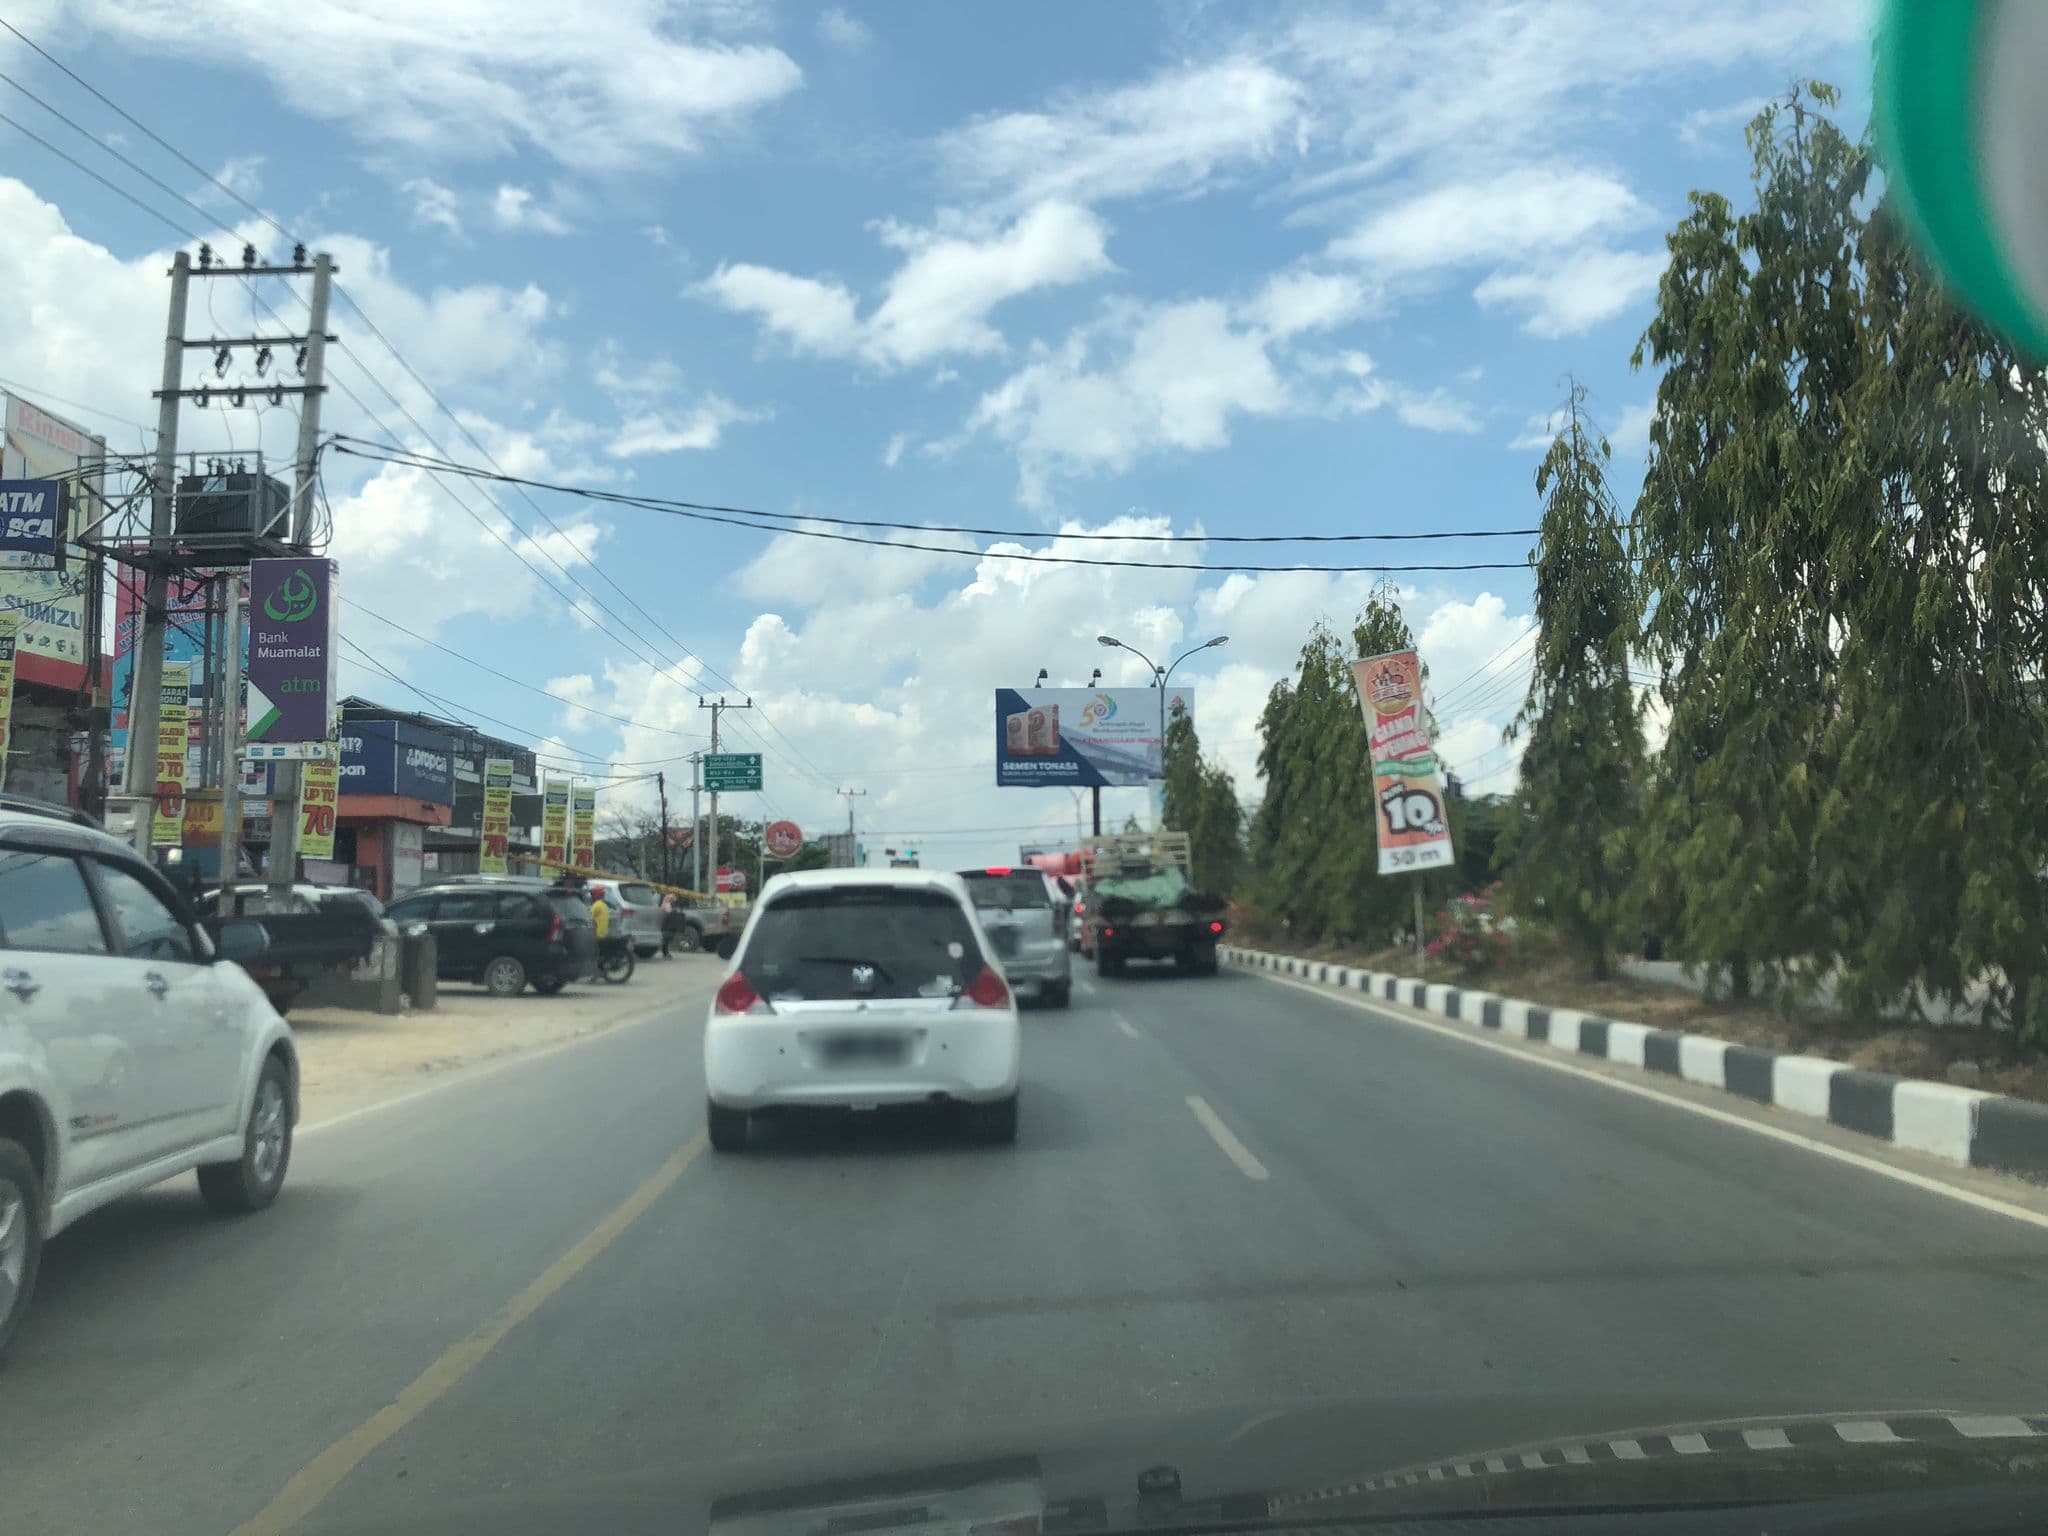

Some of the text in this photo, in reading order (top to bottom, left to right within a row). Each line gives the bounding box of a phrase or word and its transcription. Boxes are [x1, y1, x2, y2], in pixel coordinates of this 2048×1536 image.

[0, 492, 44, 513] ATM
[6, 518, 53, 538] BCA
[5, 594, 83, 630] SHIMIZU
[259, 632, 288, 643] Bank
[258, 646, 320, 658] Muamalat
[281, 677, 320, 693] atm
[304, 789, 336, 802] UP TO
[303, 805, 334, 836] 70
